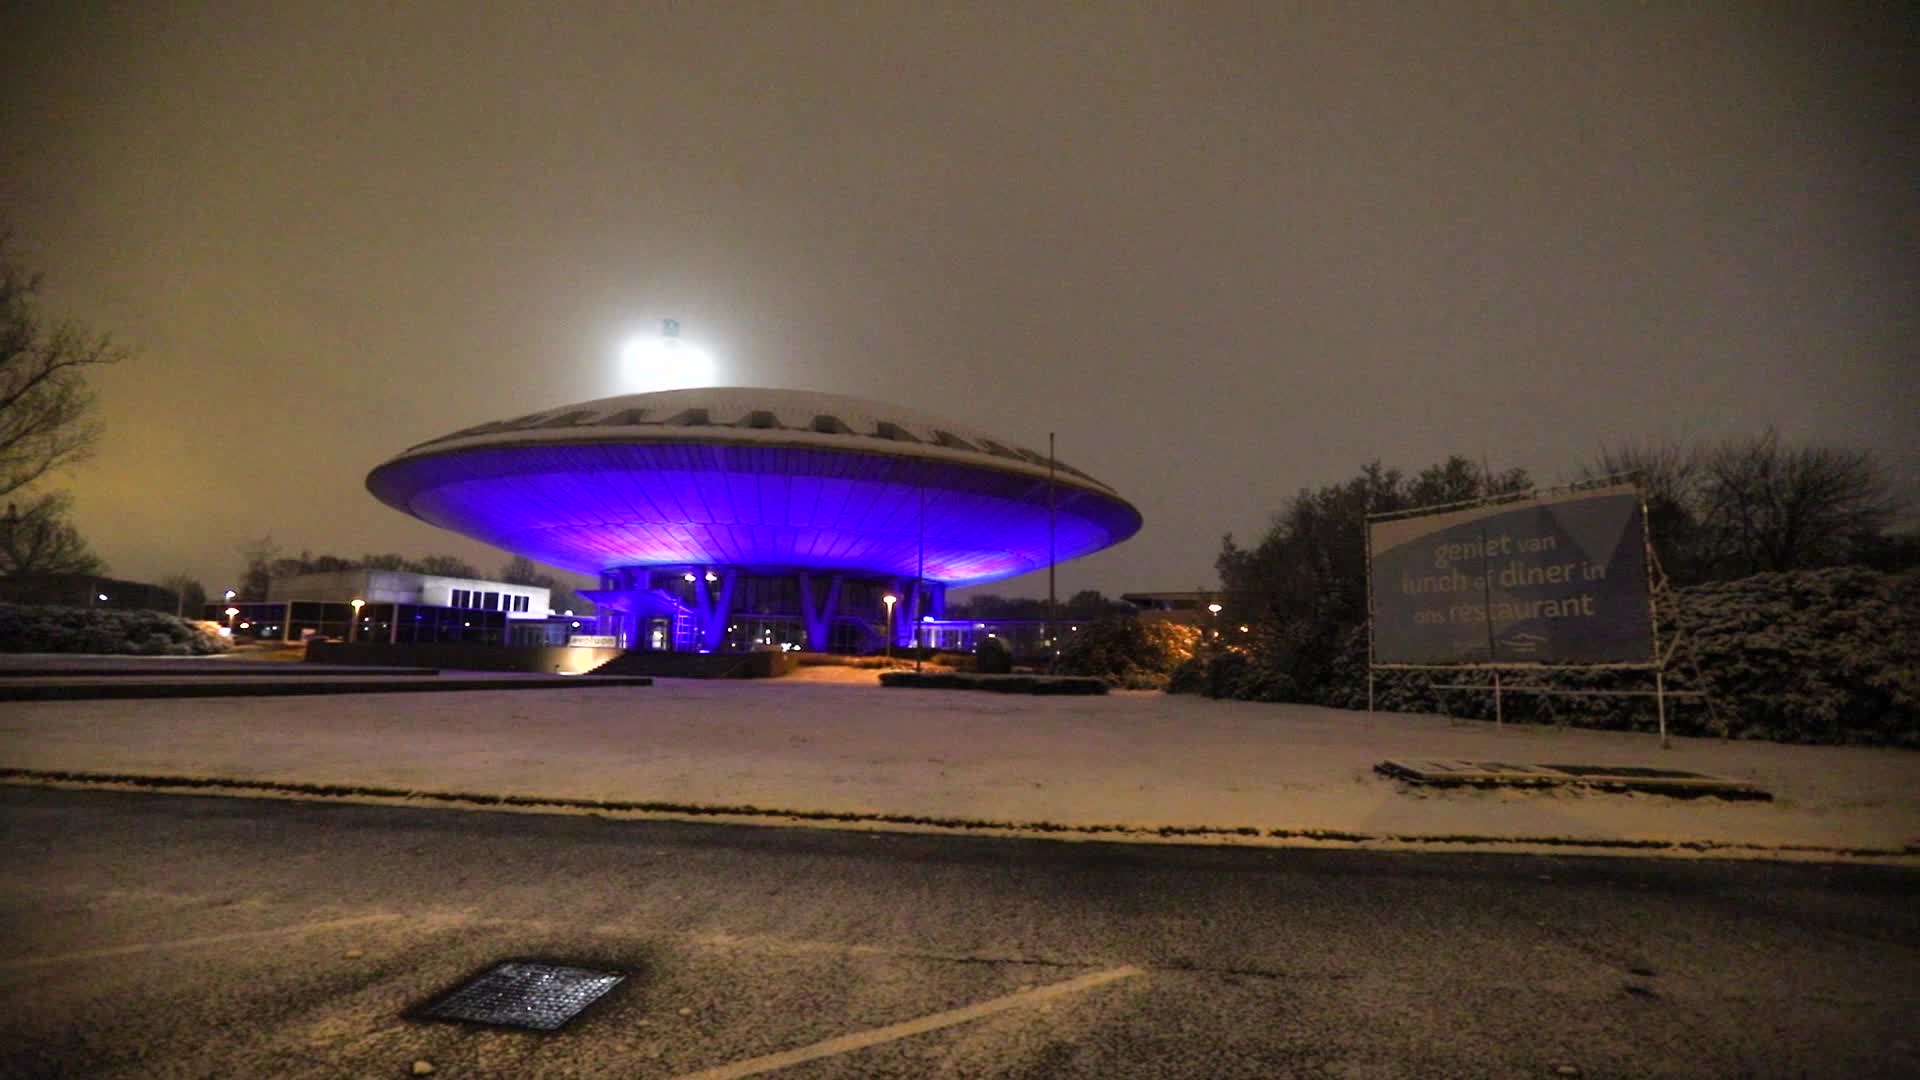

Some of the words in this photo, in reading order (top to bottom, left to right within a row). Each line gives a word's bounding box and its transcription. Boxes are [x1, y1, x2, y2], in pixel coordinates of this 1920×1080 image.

[1435, 535, 1512, 568] geniet
[1519, 533, 1556, 551] van
[1402, 568, 1469, 594] lunch
[1500, 560, 1576, 588] diner
[1583, 560, 1606, 580] in
[1414, 610, 1445, 625] ons
[1449, 593, 1596, 624] restaurant
